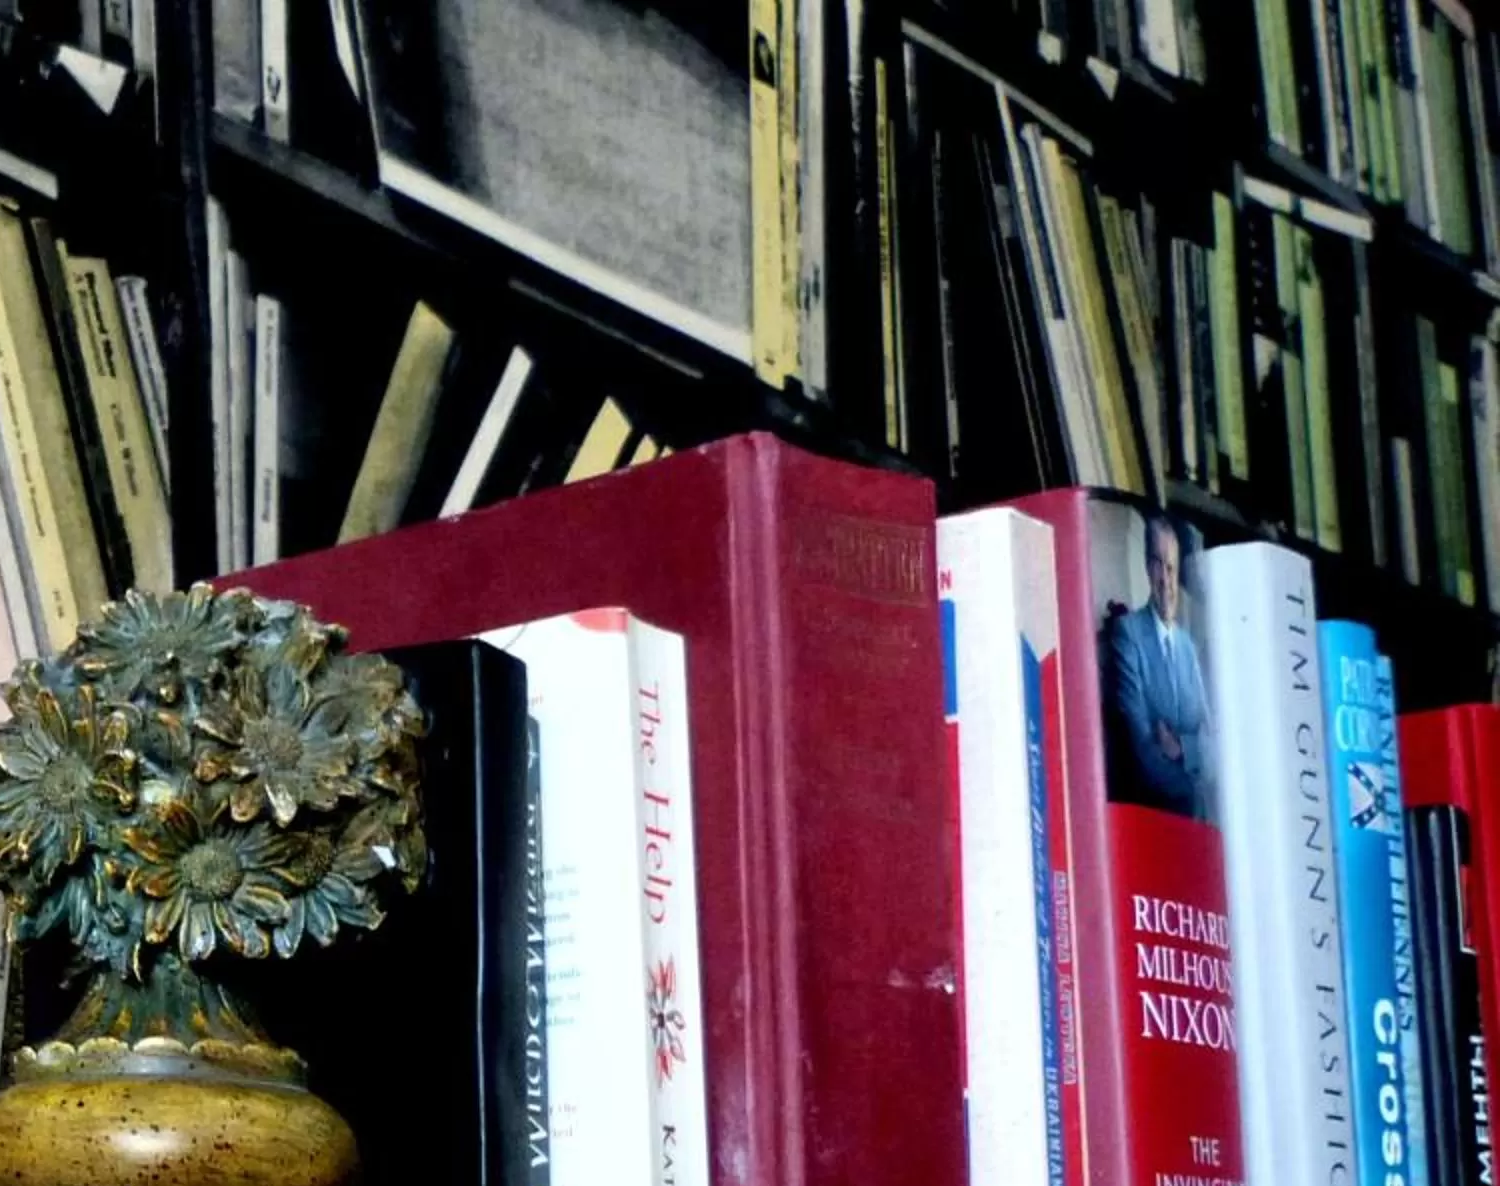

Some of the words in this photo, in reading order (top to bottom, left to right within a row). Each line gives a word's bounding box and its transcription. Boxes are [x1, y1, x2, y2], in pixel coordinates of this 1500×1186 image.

[1284, 587, 1310, 692] TIM
[638, 679, 662, 765] The
[643, 790, 673, 925] Help
[1294, 721, 1334, 952] GUNN'S
[1132, 893, 1230, 950] RICHARD
[1139, 990, 1238, 1052] NIXON
[1189, 1136, 1221, 1167] THE
